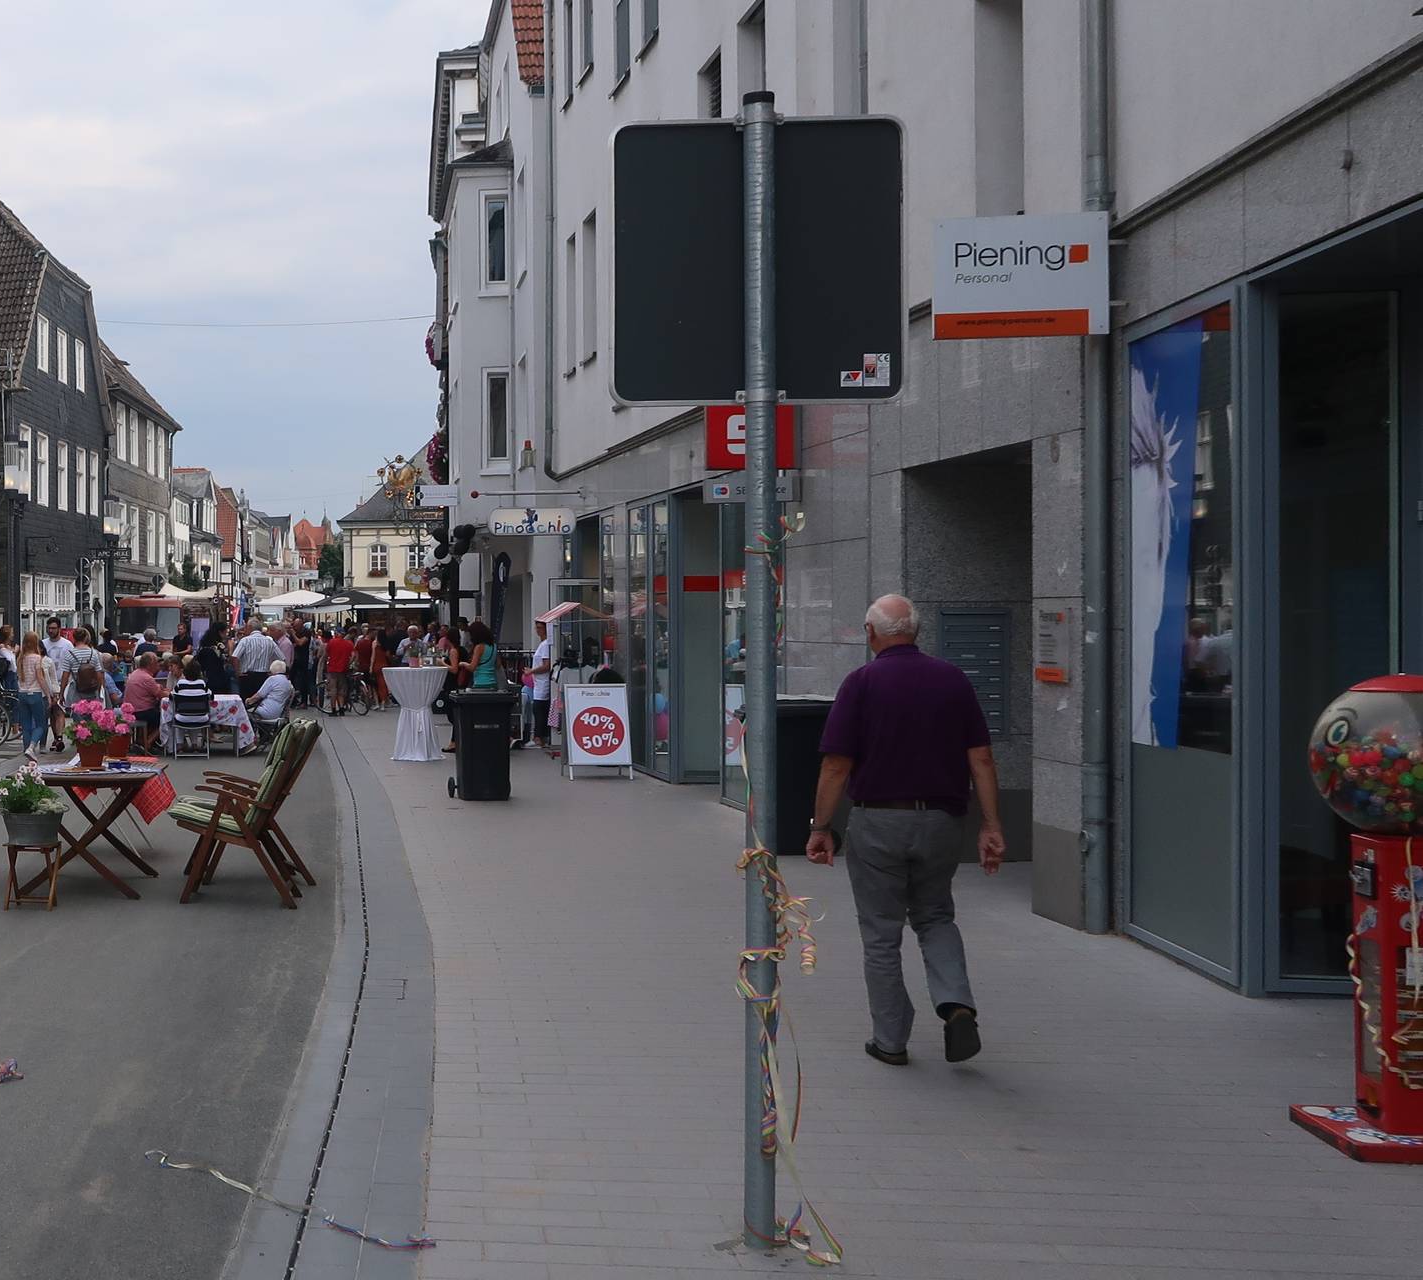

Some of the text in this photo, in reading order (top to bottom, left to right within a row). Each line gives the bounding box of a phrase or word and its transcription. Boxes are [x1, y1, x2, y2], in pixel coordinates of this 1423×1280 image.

[955, 240, 1066, 271] Piening
[955, 272, 1013, 284] Personal
[494, 515, 571, 534] Pinocchio
[580, 712, 616, 731] 40%
[582, 732, 619, 750] 50%
